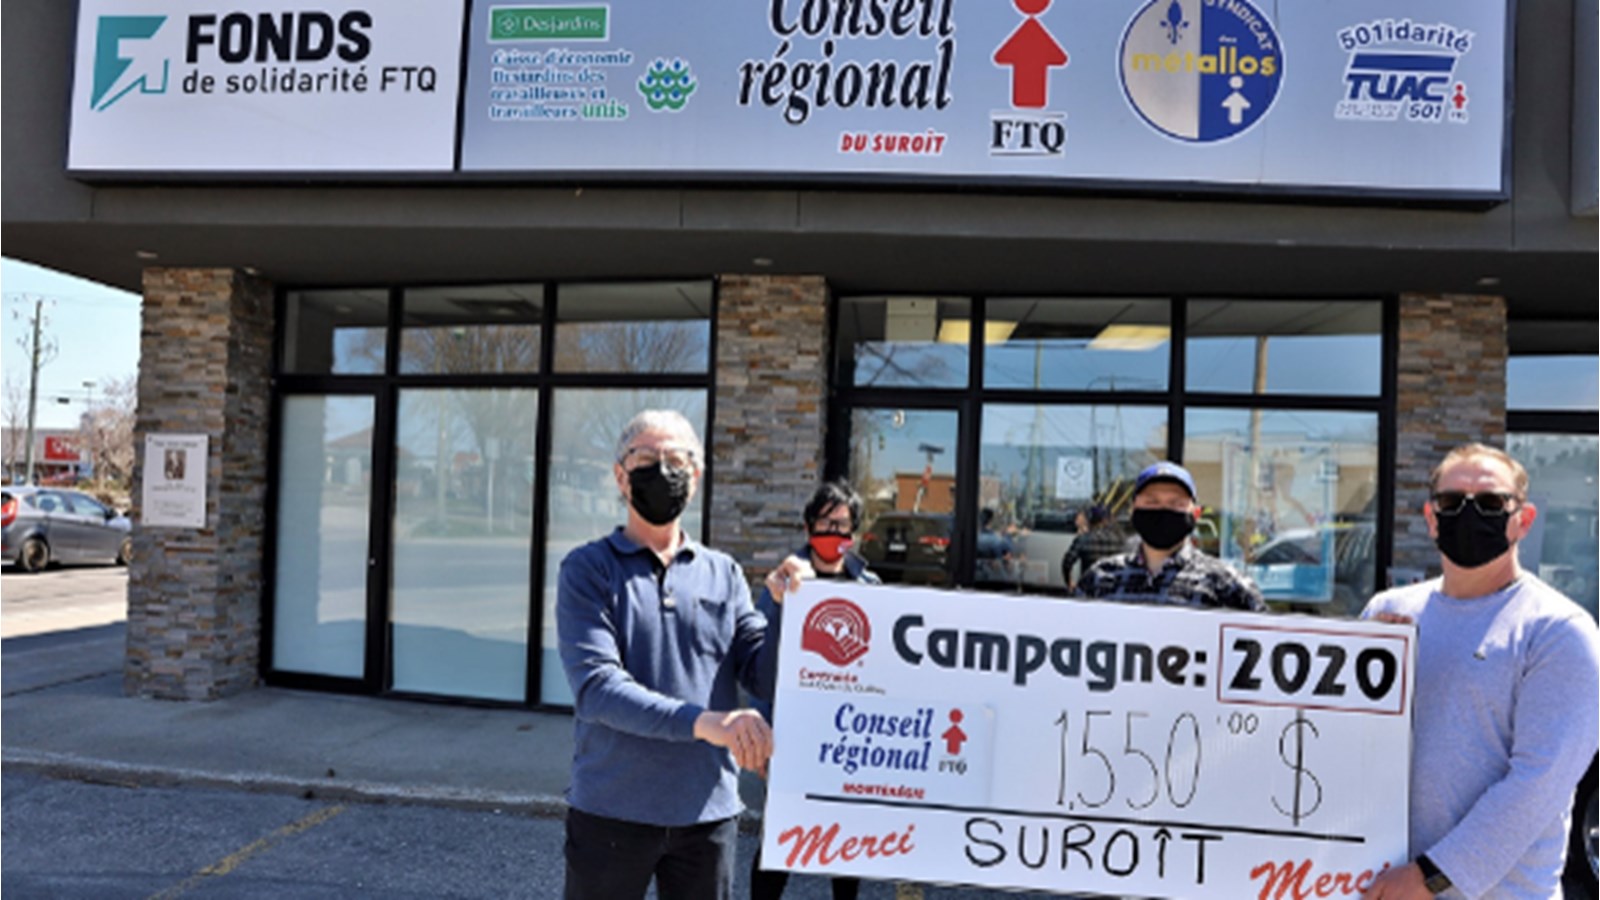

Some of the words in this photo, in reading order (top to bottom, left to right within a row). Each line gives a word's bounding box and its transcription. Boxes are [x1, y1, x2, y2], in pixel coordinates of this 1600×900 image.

[523, 15, 600, 32] Desjardins
[771, 0, 953, 36] Conseil
[185, 10, 372, 64] FONDS
[1340, 21, 1470, 52] 501idarité
[578, 67, 605, 83] des
[1131, 46, 1276, 75] métallos
[183, 71, 214, 94] de
[226, 66, 368, 94] solidarité
[380, 67, 436, 92] FTQ
[739, 40, 953, 124] régional
[1346, 74, 1449, 102] TUAC
[582, 101, 627, 118] unis
[1409, 103, 1442, 119] 501
[841, 134, 866, 152] DU
[991, 120, 1066, 153] FTQ
[892, 614, 1207, 692] Campagne:
[1230, 638, 1397, 701] 2020
[835, 703, 933, 739] Conseil
[818, 735, 932, 775] régional
[938, 759, 968, 776] FTQ
[1270, 708, 1323, 827] $
[778, 823, 916, 867] Merci
[964, 817, 1224, 884] SUROÎT
